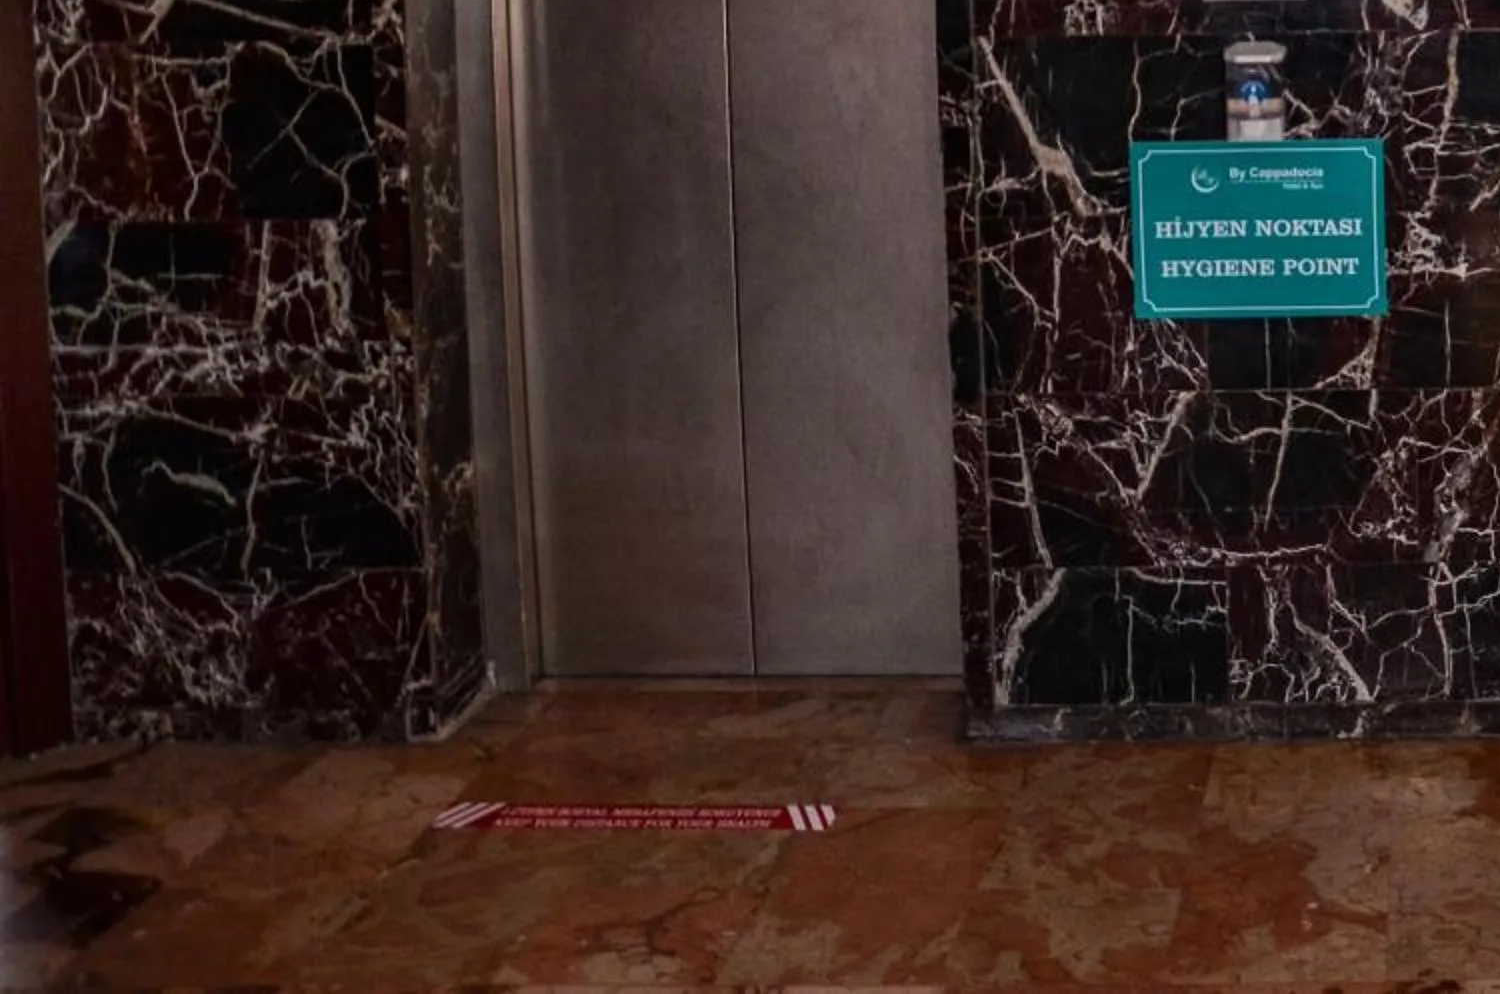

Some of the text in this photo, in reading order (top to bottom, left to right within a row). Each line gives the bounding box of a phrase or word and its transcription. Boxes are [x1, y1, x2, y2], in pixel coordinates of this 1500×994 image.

[1228, 166, 1325, 182] By Cappadocia
[1155, 215, 1363, 239] HİJYEN NOKTASI
[1160, 257, 1360, 278] HYGIENE POINT
